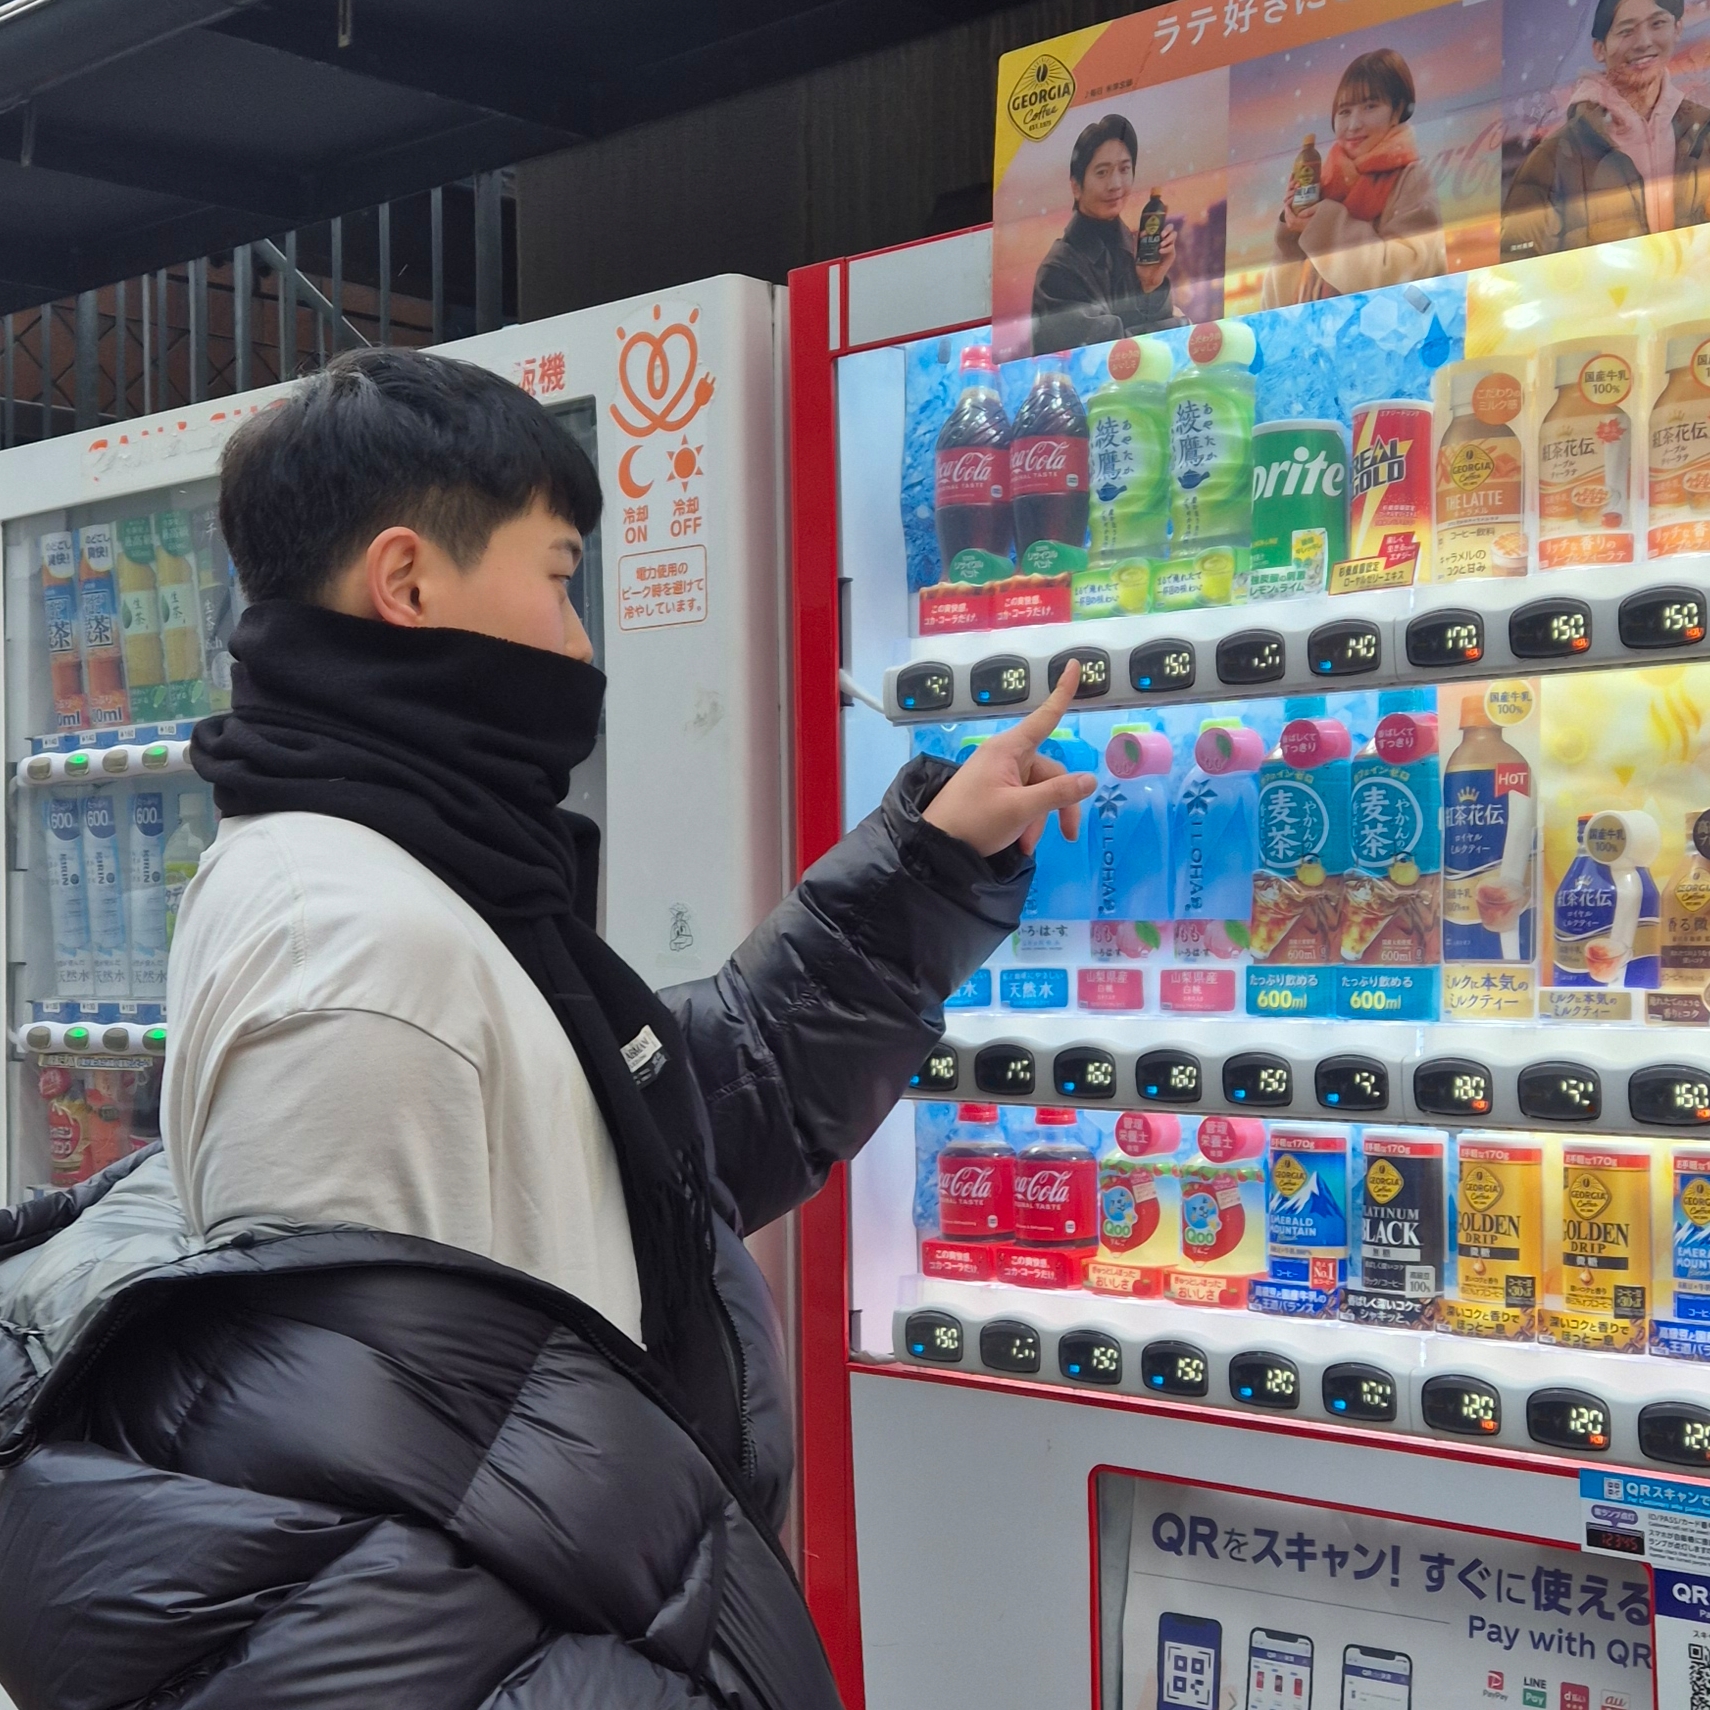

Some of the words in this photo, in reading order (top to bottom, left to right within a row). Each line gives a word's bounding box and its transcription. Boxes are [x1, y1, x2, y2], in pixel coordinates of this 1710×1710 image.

[1012, 85, 1071, 111] GEORGIA
[1023, 104, 1058, 125] Coffee
[1584, 370, 1629, 383] 国産牛乳
[1476, 388, 1521, 400] こだわりの
[1592, 383, 1620, 395] 100%
[1177, 400, 1204, 467] 綾鷹
[1203, 403, 1217, 462] あやたか
[1652, 421, 1709, 449] 紅茶花伝
[1095, 416, 1122, 480] 綾鷹
[1121, 420, 1134, 474] あやたか
[1541, 437, 1596, 463] 紅茶花伝
[1254, 446, 1345, 501] prite
[1452, 462, 1492, 475] GEORGIA
[673, 496, 699, 516] 冷却
[1462, 490, 1503, 507] LATTE
[623, 505, 648, 525] 冷却
[625, 525, 648, 544] ON
[670, 516, 702, 537] OFF
[636, 562, 688, 581] 電力使用の
[622, 578, 704, 600] ピーク時を避けて
[624, 598, 701, 619] 冷やしています。
[1663, 602, 1699, 630] 150
[1552, 614, 1584, 640] 150
[1003, 668, 1025, 690] 190
[1489, 690, 1533, 703] 国産牛乳
[1497, 704, 1524, 715] 100%
[1377, 737, 1414, 748] すっきり
[1498, 772, 1528, 786] HOT
[51, 812, 72, 829] 600
[87, 810, 108, 827] 600
[136, 807, 157, 824] 600
[1267, 789, 1302, 860] 麦茶
[1360, 786, 1394, 859] 麦茶
[60, 853, 69, 886] KIRIN
[96, 851, 105, 884] KIRIN
[142, 849, 150, 883] KIRIN
[1556, 888, 1615, 908] 紅茶花伝
[57, 969, 90, 984] 天然水
[1086, 972, 1128, 984] 山梨県産
[1171, 972, 1218, 985] 山梨県産
[1250, 973, 1318, 987] たっぷり飲める
[1341, 975, 1413, 988] たっぷり飲める
[1010, 981, 1053, 998] 天然水
[1257, 990, 1307, 1009] 600ml
[1350, 990, 1401, 1010] 600ml
[1274, 1171, 1305, 1179] GEORGIA
[1369, 1177, 1398, 1185] GEORGIA
[1465, 1183, 1499, 1193] GEORGIA
[1570, 1190, 1608, 1200] GEORGIA
[1103, 1219, 1131, 1237] Qoo
[1185, 1228, 1215, 1245] Qoo
[1465, 1232, 1499, 1245] DRIP
[1570, 1241, 1607, 1254] DRIP
[1314, 1262, 1334, 1281] No.1
[1095, 1276, 1131, 1290] おいしさ
[1178, 1286, 1215, 1300] おいしさ
[1446, 1304, 1520, 1325] 深いコクと香りで
[1456, 1318, 1506, 1334] ほっと一息
[1550, 1315, 1629, 1336] 深いコクと香りで
[1562, 1329, 1614, 1345] ほっと一息
[1462, 1393, 1494, 1420] 120
[1569, 1407, 1603, 1435] 120
[1152, 1511, 1401, 1588] QRをスキャン!
[1419, 1552, 1654, 1627] すぐに使える
[1672, 1583, 1710, 1605] QR
[1469, 1614, 1520, 1651] Pay
[1529, 1628, 1595, 1660] with
[1606, 1639, 1653, 1670] QR
[1524, 1676, 1547, 1689] LINE
[1525, 1691, 1545, 1703] Pay
